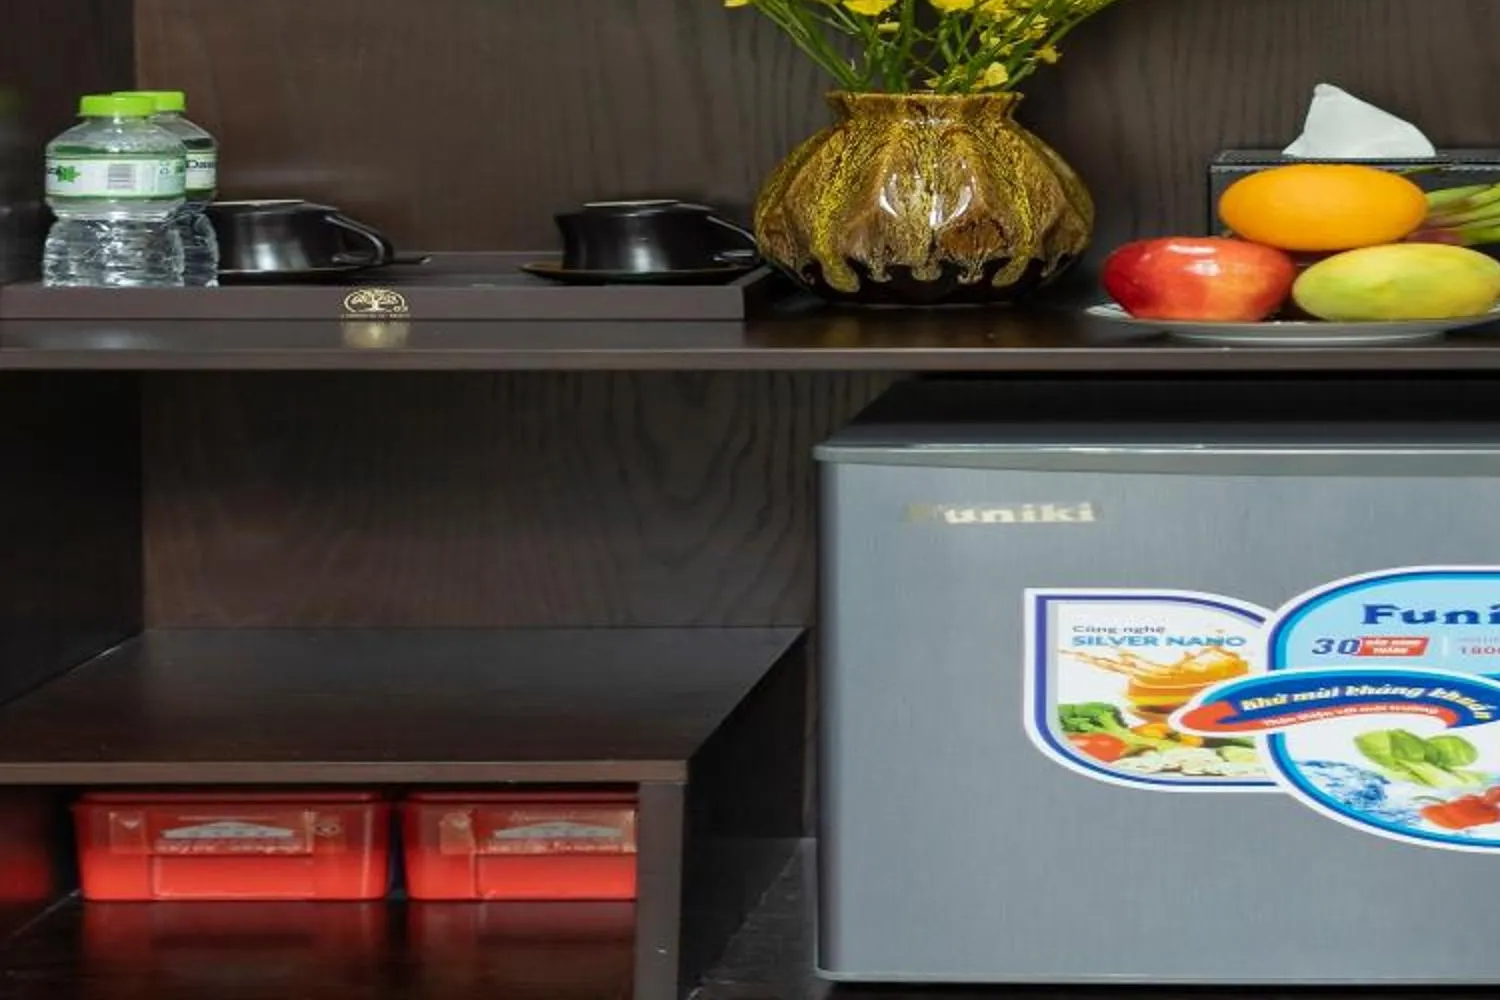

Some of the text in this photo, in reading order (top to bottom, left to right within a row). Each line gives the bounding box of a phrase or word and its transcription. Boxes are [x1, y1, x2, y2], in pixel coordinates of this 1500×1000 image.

[1071, 635, 1248, 647] SILVER NANO
[1311, 637, 1361, 655] 30
